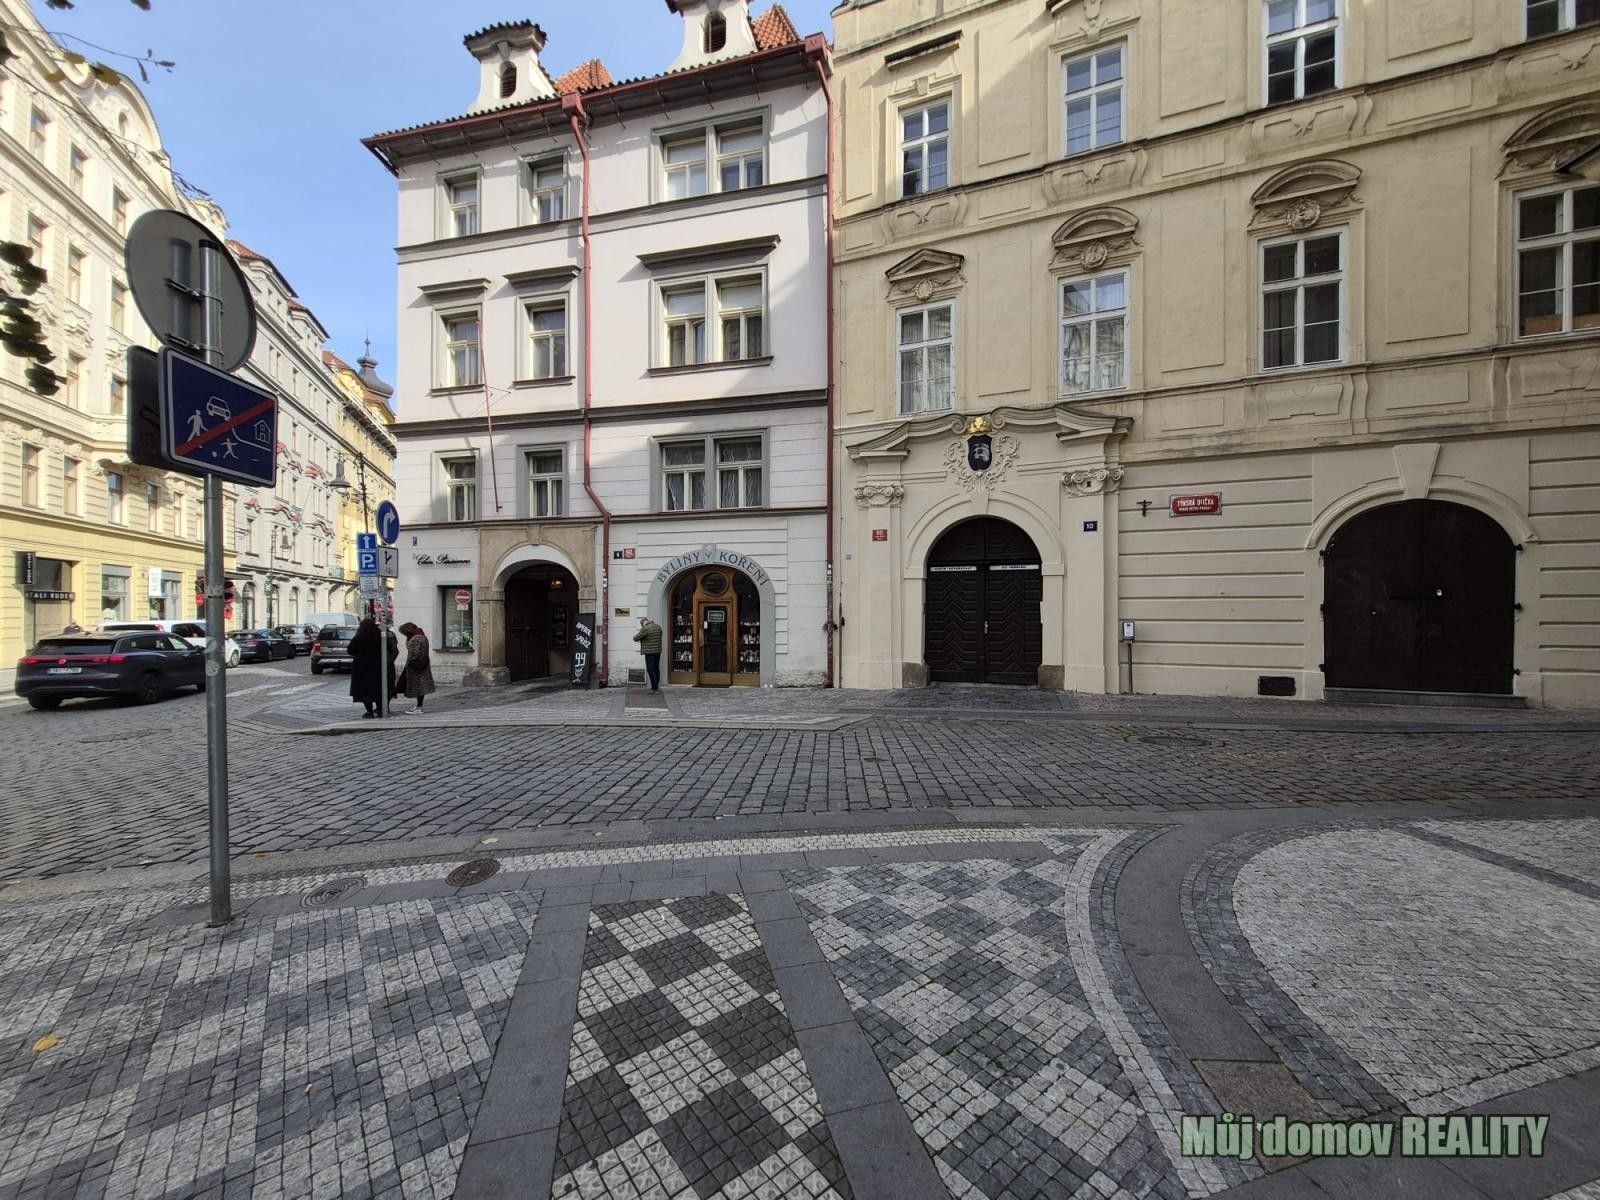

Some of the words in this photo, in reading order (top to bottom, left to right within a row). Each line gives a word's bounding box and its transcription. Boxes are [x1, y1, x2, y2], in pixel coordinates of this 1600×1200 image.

[657, 551, 700, 583] BYLINY
[719, 551, 771, 586] KOŘENÍ
[574, 652, 587, 667] 99
